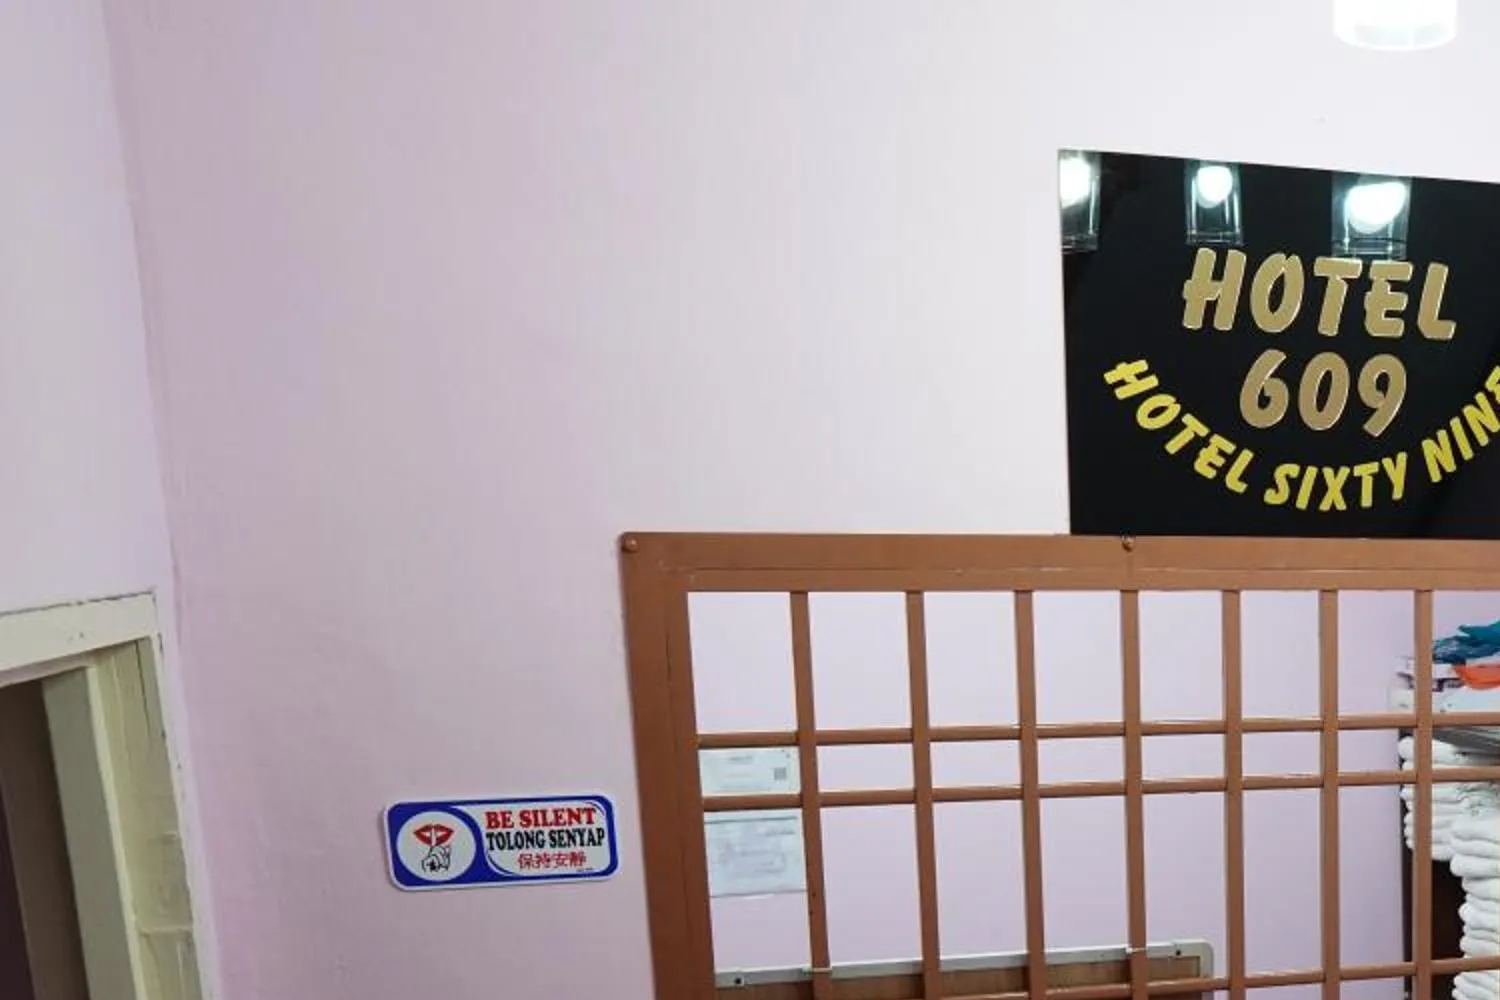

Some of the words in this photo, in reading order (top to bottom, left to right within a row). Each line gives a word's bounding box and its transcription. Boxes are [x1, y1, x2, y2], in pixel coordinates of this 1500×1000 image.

[1183, 247, 1456, 340] HOTEL
[1103, 359, 1254, 494] HOTEL
[1263, 452, 1408, 512] SIXTY
[1239, 348, 1407, 438] 609
[485, 811, 514, 829] BE
[519, 807, 596, 828] SILENT
[485, 829, 545, 851] TOLONG
[548, 827, 605, 849] SENYAP
